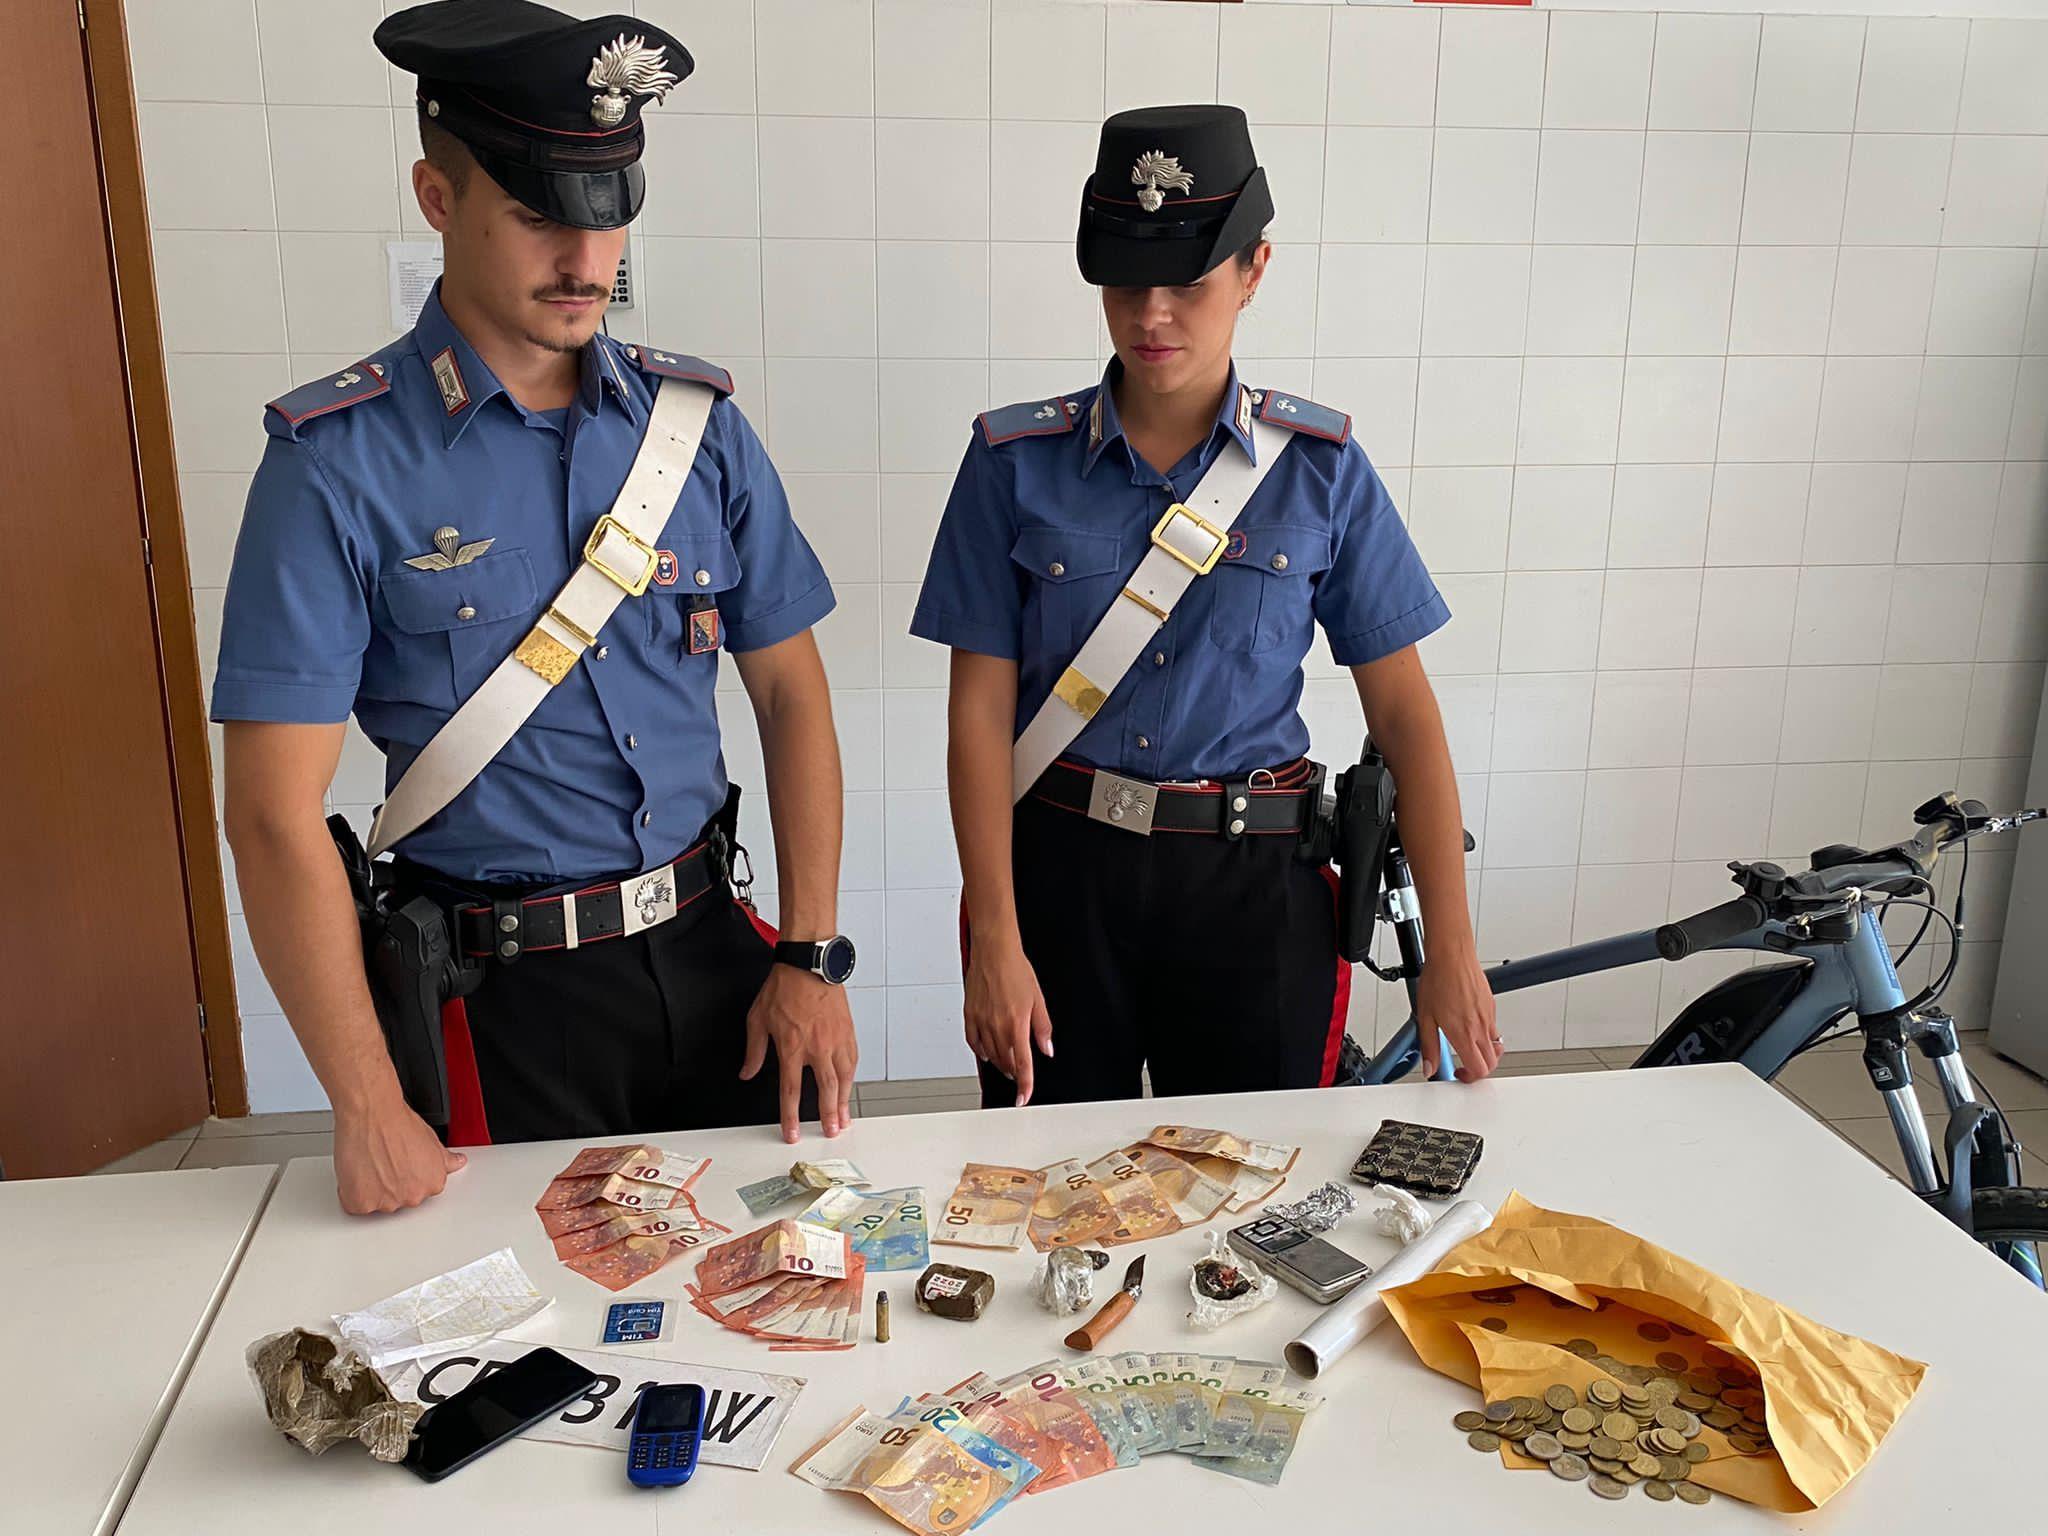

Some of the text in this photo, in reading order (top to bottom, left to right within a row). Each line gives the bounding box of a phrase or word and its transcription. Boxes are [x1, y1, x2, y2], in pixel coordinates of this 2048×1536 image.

[633, 1166, 660, 1180] 10
[1112, 1164, 1141, 1181] 50
[1065, 1173, 1092, 1191] 50
[615, 1192, 641, 1206] 10
[899, 1205, 922, 1222] 20
[946, 1205, 973, 1226] 50
[640, 1221, 670, 1233] 10
[854, 1215, 883, 1230] 20
[669, 1235, 699, 1248] 10
[785, 1255, 814, 1271] 10
[621, 1333, 644, 1341] TIM
[1031, 1373, 1064, 1402] 10
[920, 1407, 960, 1432] 20
[855, 1425, 873, 1436] EURO
[879, 1427, 920, 1447] 50
